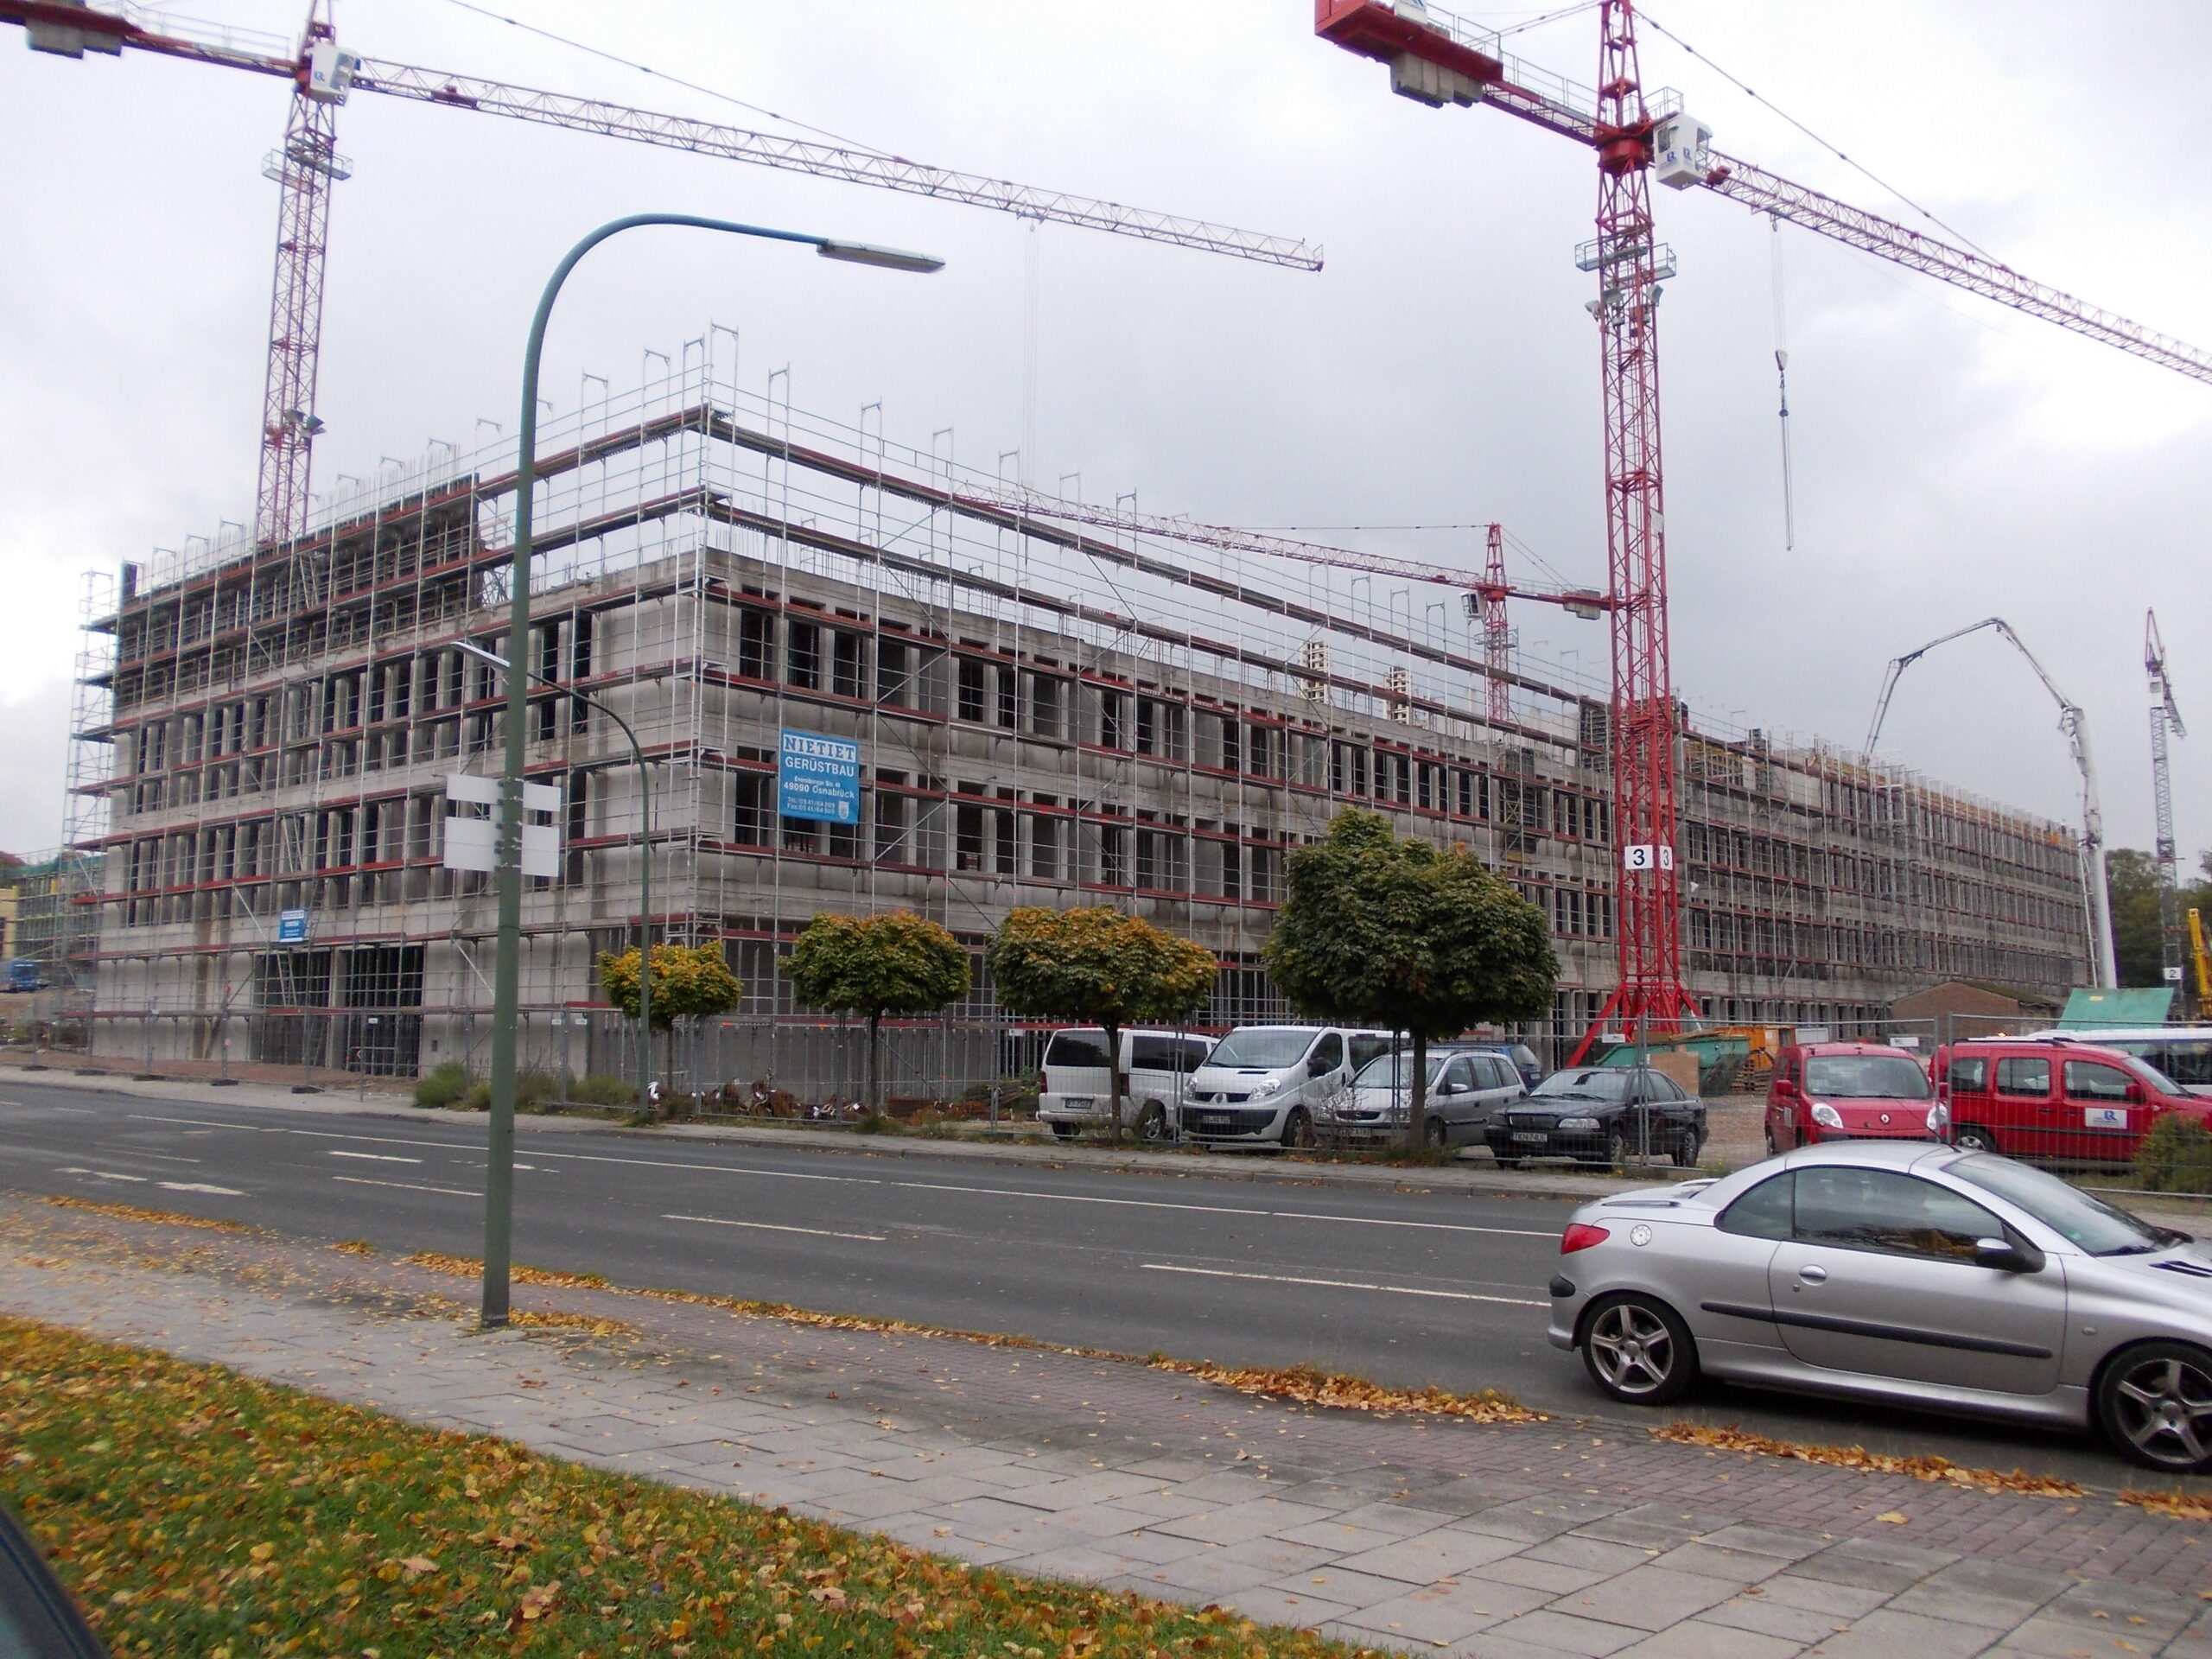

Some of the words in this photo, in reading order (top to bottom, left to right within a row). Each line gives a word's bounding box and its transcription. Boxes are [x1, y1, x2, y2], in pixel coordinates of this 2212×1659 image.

[785, 737, 855, 760] NIETIET
[785, 756, 855, 778] GERÜSTBAU
[784, 781, 810, 792] 49090
[812, 785, 855, 799] Osnabrück
[1633, 849, 1645, 866] 3
[1663, 849, 1669, 866] 3
[2170, 969, 2177, 978] 2
